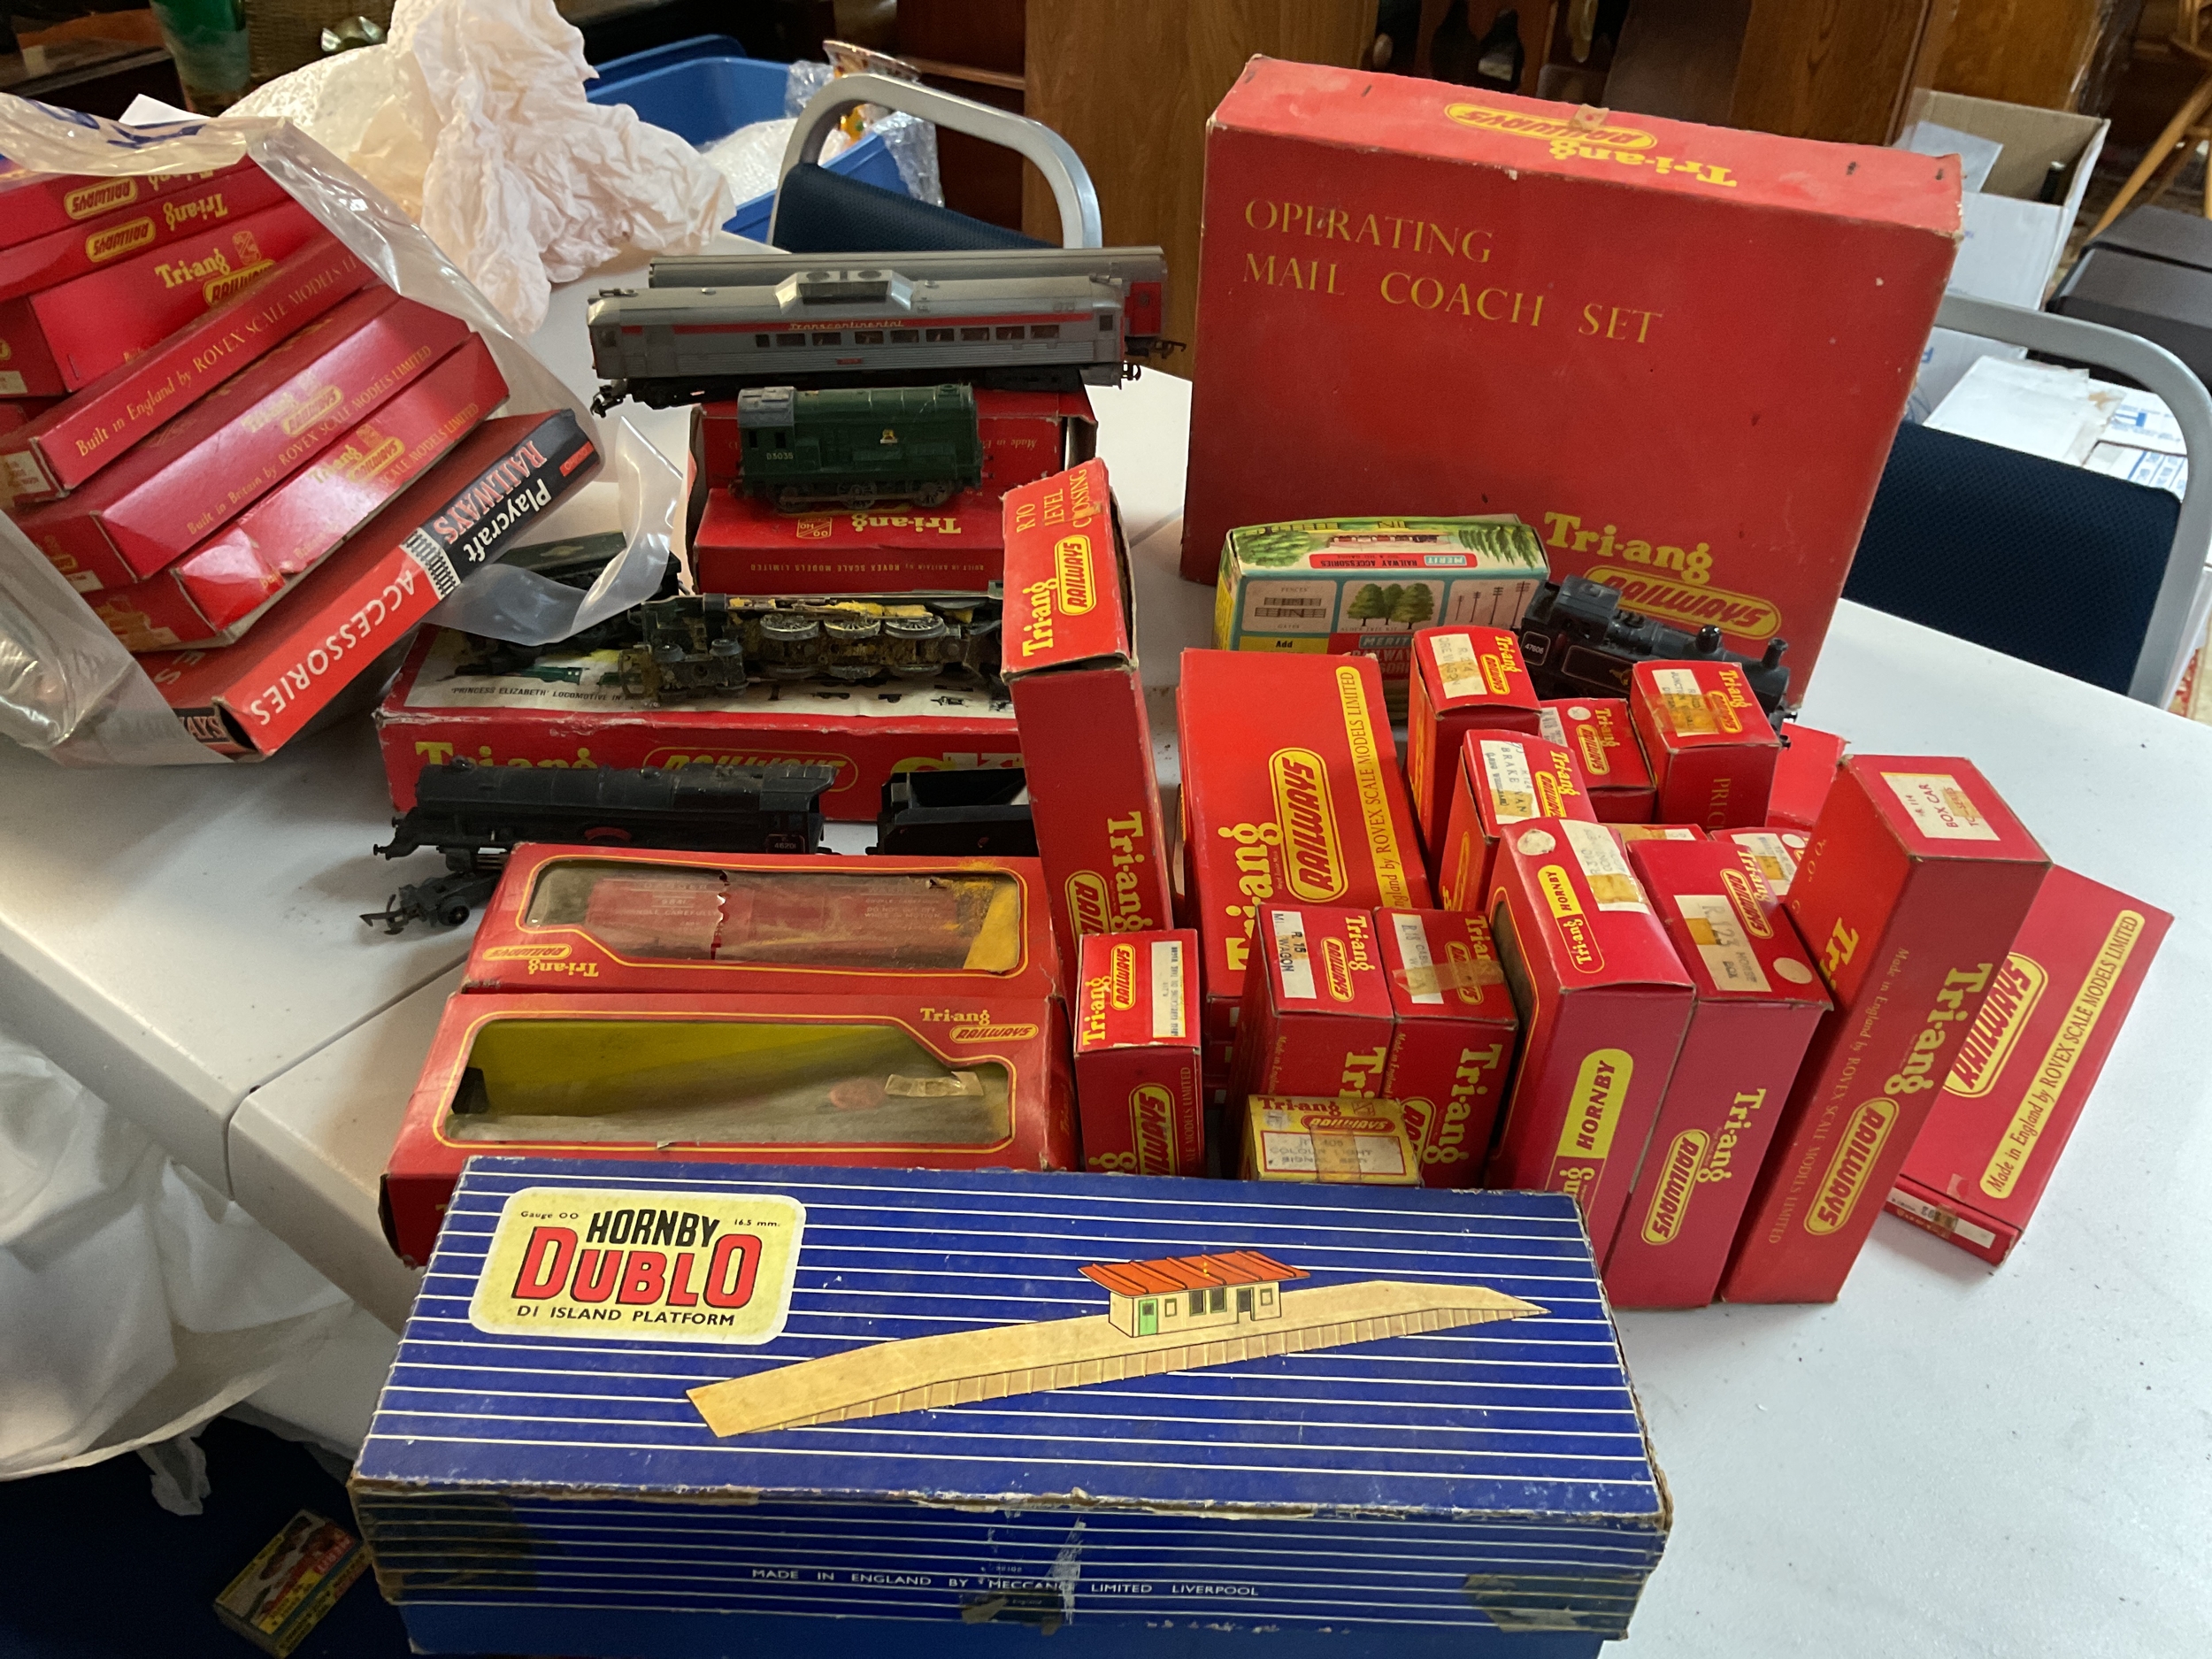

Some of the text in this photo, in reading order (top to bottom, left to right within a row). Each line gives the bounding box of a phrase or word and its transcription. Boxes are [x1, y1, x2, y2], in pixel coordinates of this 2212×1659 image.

[1549, 140, 1737, 188] Tri-ang
[163, 193, 227, 231] Tri-ang
[1245, 197, 1494, 263] OPERATING
[155, 248, 230, 288] Tri-ang
[1243, 253, 1663, 343] MAIL COACH SET
[788, 320, 904, 331] Transcontinental
[76, 266, 342, 457] Built in England by ROVEX SCALE MODELS
[264, 465, 278, 480] by
[279, 431, 319, 466] ROVEX
[320, 409, 354, 434] SCALE
[355, 375, 393, 411] MODELS
[393, 346, 432, 383] LIMITED
[380, 403, 480, 486] SCALE MODELS LIMITED
[766, 452, 794, 461] D3035
[433, 441, 547, 544] RAILWAYS
[1044, 488, 1064, 526] LEVEL
[1070, 469, 1092, 527] COSSING
[464, 478, 552, 562] Playcraft
[851, 513, 961, 534] Tri-ang
[750, 563, 790, 572] LIMITED
[794, 563, 832, 572] MODELS
[836, 563, 865, 572] SCALE
[1320, 556, 1464, 567] MERIT RAILWAY ACCESSORIES
[1544, 511, 1713, 585] Tri-ang
[1064, 541, 1087, 608] RAILWAYS
[1023, 578, 1057, 657] Tri-ang
[1603, 575, 1772, 628] RAILWAYS
[250, 570, 416, 726] ACCESSORIES
[1363, 637, 1409, 647] MERIT
[1495, 636, 1522, 672] Tri-ang
[553, 691, 609, 701] LOCOMOTIVE
[1719, 671, 1752, 707] Tri-ang
[1582, 728, 1605, 770] RAILWAYS
[1595, 709, 1620, 747] Tri-ang
[1340, 672, 1409, 909] ngland by ROVEX SCALE MODELS LIMITED
[1502, 747, 1520, 783] BRAKE
[1514, 791, 1527, 812] VAN
[1550, 750, 1580, 795] Tri-ang
[1282, 757, 1334, 893] RAILWAYS
[1918, 783, 1958, 828] BOX CAR
[1108, 811, 1153, 931] Tri-ang
[1546, 871, 1572, 911] HORNBY
[1737, 850, 1769, 901] Tri-ang
[1726, 872, 1769, 935] RAILWAYS
[489, 947, 567, 957] RAILWAYS
[1278, 939, 1294, 972] WAGON
[1345, 915, 1376, 972] Tri-ang
[1563, 919, 1592, 964] Tri-ang
[1886, 948, 1909, 978] Made
[528, 959, 599, 977] Tri-ang
[1116, 948, 1130, 1005] RAILWAYS
[1326, 941, 1349, 999] RAILWAYS
[1723, 960, 1739, 979] BOX
[1879, 981, 1890, 992] in
[920, 1008, 990, 1026] Tri-ang
[1082, 975, 1112, 1046] Tri-ang
[1860, 996, 1887, 1038] England
[1885, 963, 1993, 1094] Tri-ang
[1952, 957, 2032, 1090] RAILWAYS
[956, 1027, 1033, 1040] RAILWAYS
[1987, 916, 2139, 1192] Made in England by ROVEX SCALE MODELS LIMITED
[1831, 1056, 1861, 1101] ROVEX
[1258, 1097, 1341, 1117] Tri-ang
[1422, 1043, 1502, 1164] Tri-ang
[1576, 1060, 1615, 1150] HORNBY
[1813, 1105, 1838, 1141] SCALE
[1696, 1088, 1766, 1183] Tri-ang
[1651, 1137, 1700, 1238] RAILWAYS
[1790, 1145, 1818, 1194] MODELS
[1817, 1107, 1886, 1226] RAILWAYS
[520, 1210, 553, 1219] Gauge
[586, 1209, 720, 1248] HORNBY
[1769, 1196, 1797, 1244] LIMITED
[511, 1226, 763, 1310] DUBLO
[550, 1307, 734, 1325] ISLAND PLATFORM
[752, 1569, 1259, 1596] MADE IN ENGLAND BY MECCANO LIMITED LIVERPOOL
